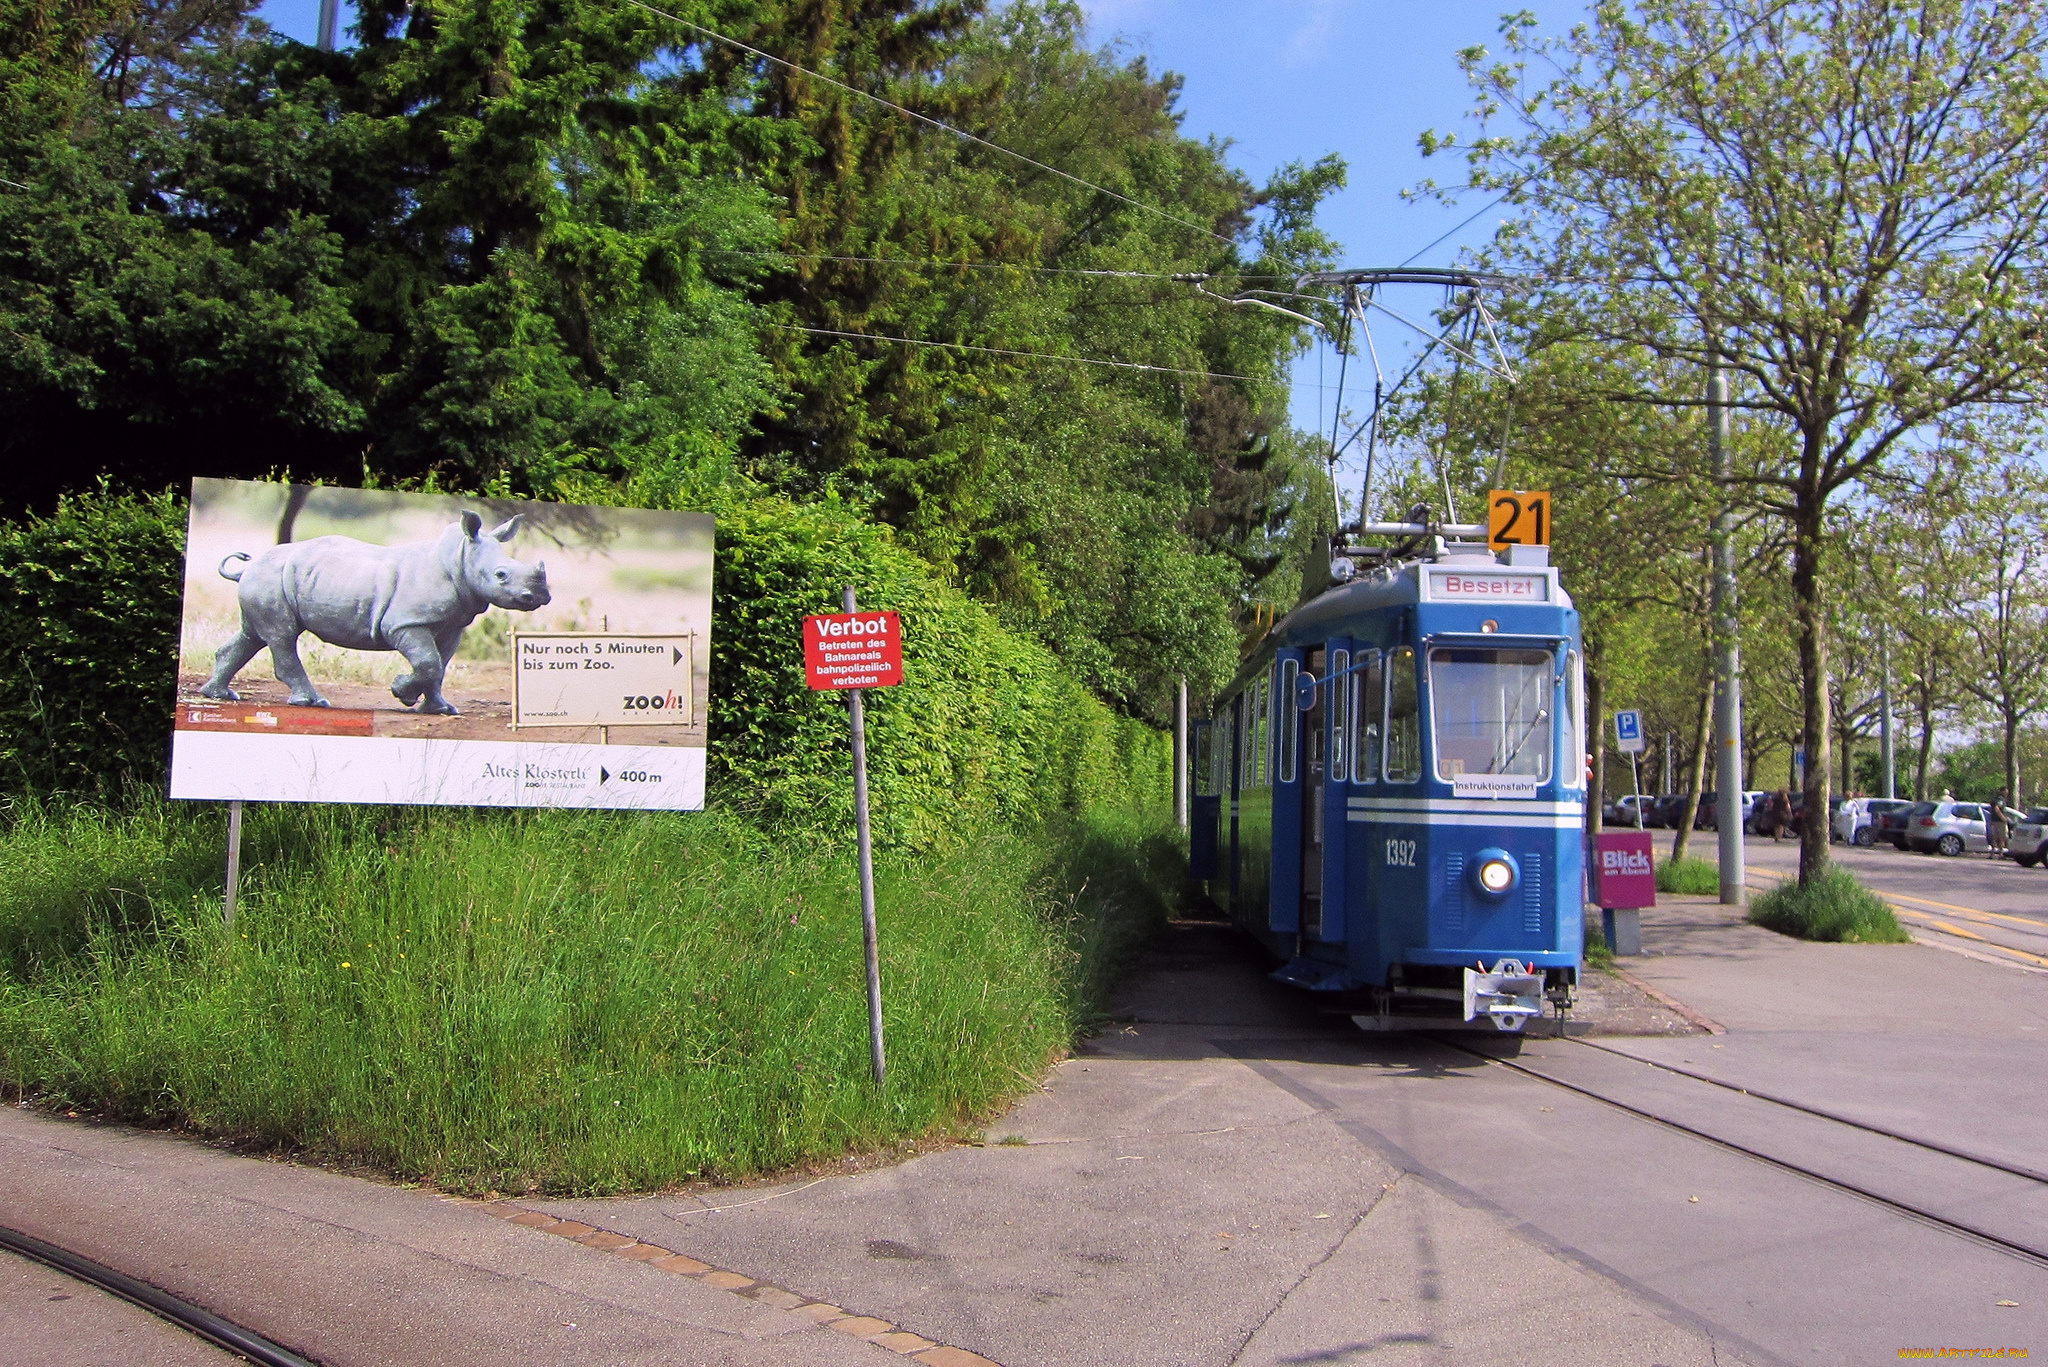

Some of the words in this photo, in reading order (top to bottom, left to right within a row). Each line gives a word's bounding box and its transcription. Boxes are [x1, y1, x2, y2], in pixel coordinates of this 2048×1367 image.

[1493, 496, 1544, 544] 21
[1446, 576, 1533, 595] Besetzt
[815, 616, 888, 637] Verbot
[523, 643, 550, 654] Nur
[555, 642, 588, 654] noch
[594, 643, 603, 654] 5
[608, 642, 664, 654] Minuten
[818, 640, 863, 651] Betreten
[866, 639, 886, 648] des
[824, 651, 881, 662] Bahnareals
[523, 659, 543, 670] bis
[549, 661, 578, 670] zum
[583, 659, 615, 670] Zoo.
[816, 662, 892, 675] bahnpolizeilich
[832, 675, 878, 685] verboten
[1623, 714, 1634, 730] P
[482, 762, 520, 779] Altes
[525, 763, 588, 780] Klösterli
[619, 770, 647, 783] 400
[649, 774, 662, 783] m
[1455, 781, 1535, 791] Instruktionsfahrt
[1386, 839, 1416, 867] 1392
[1602, 849, 1651, 868] Blick
[1621, 867, 1651, 876] Abend
